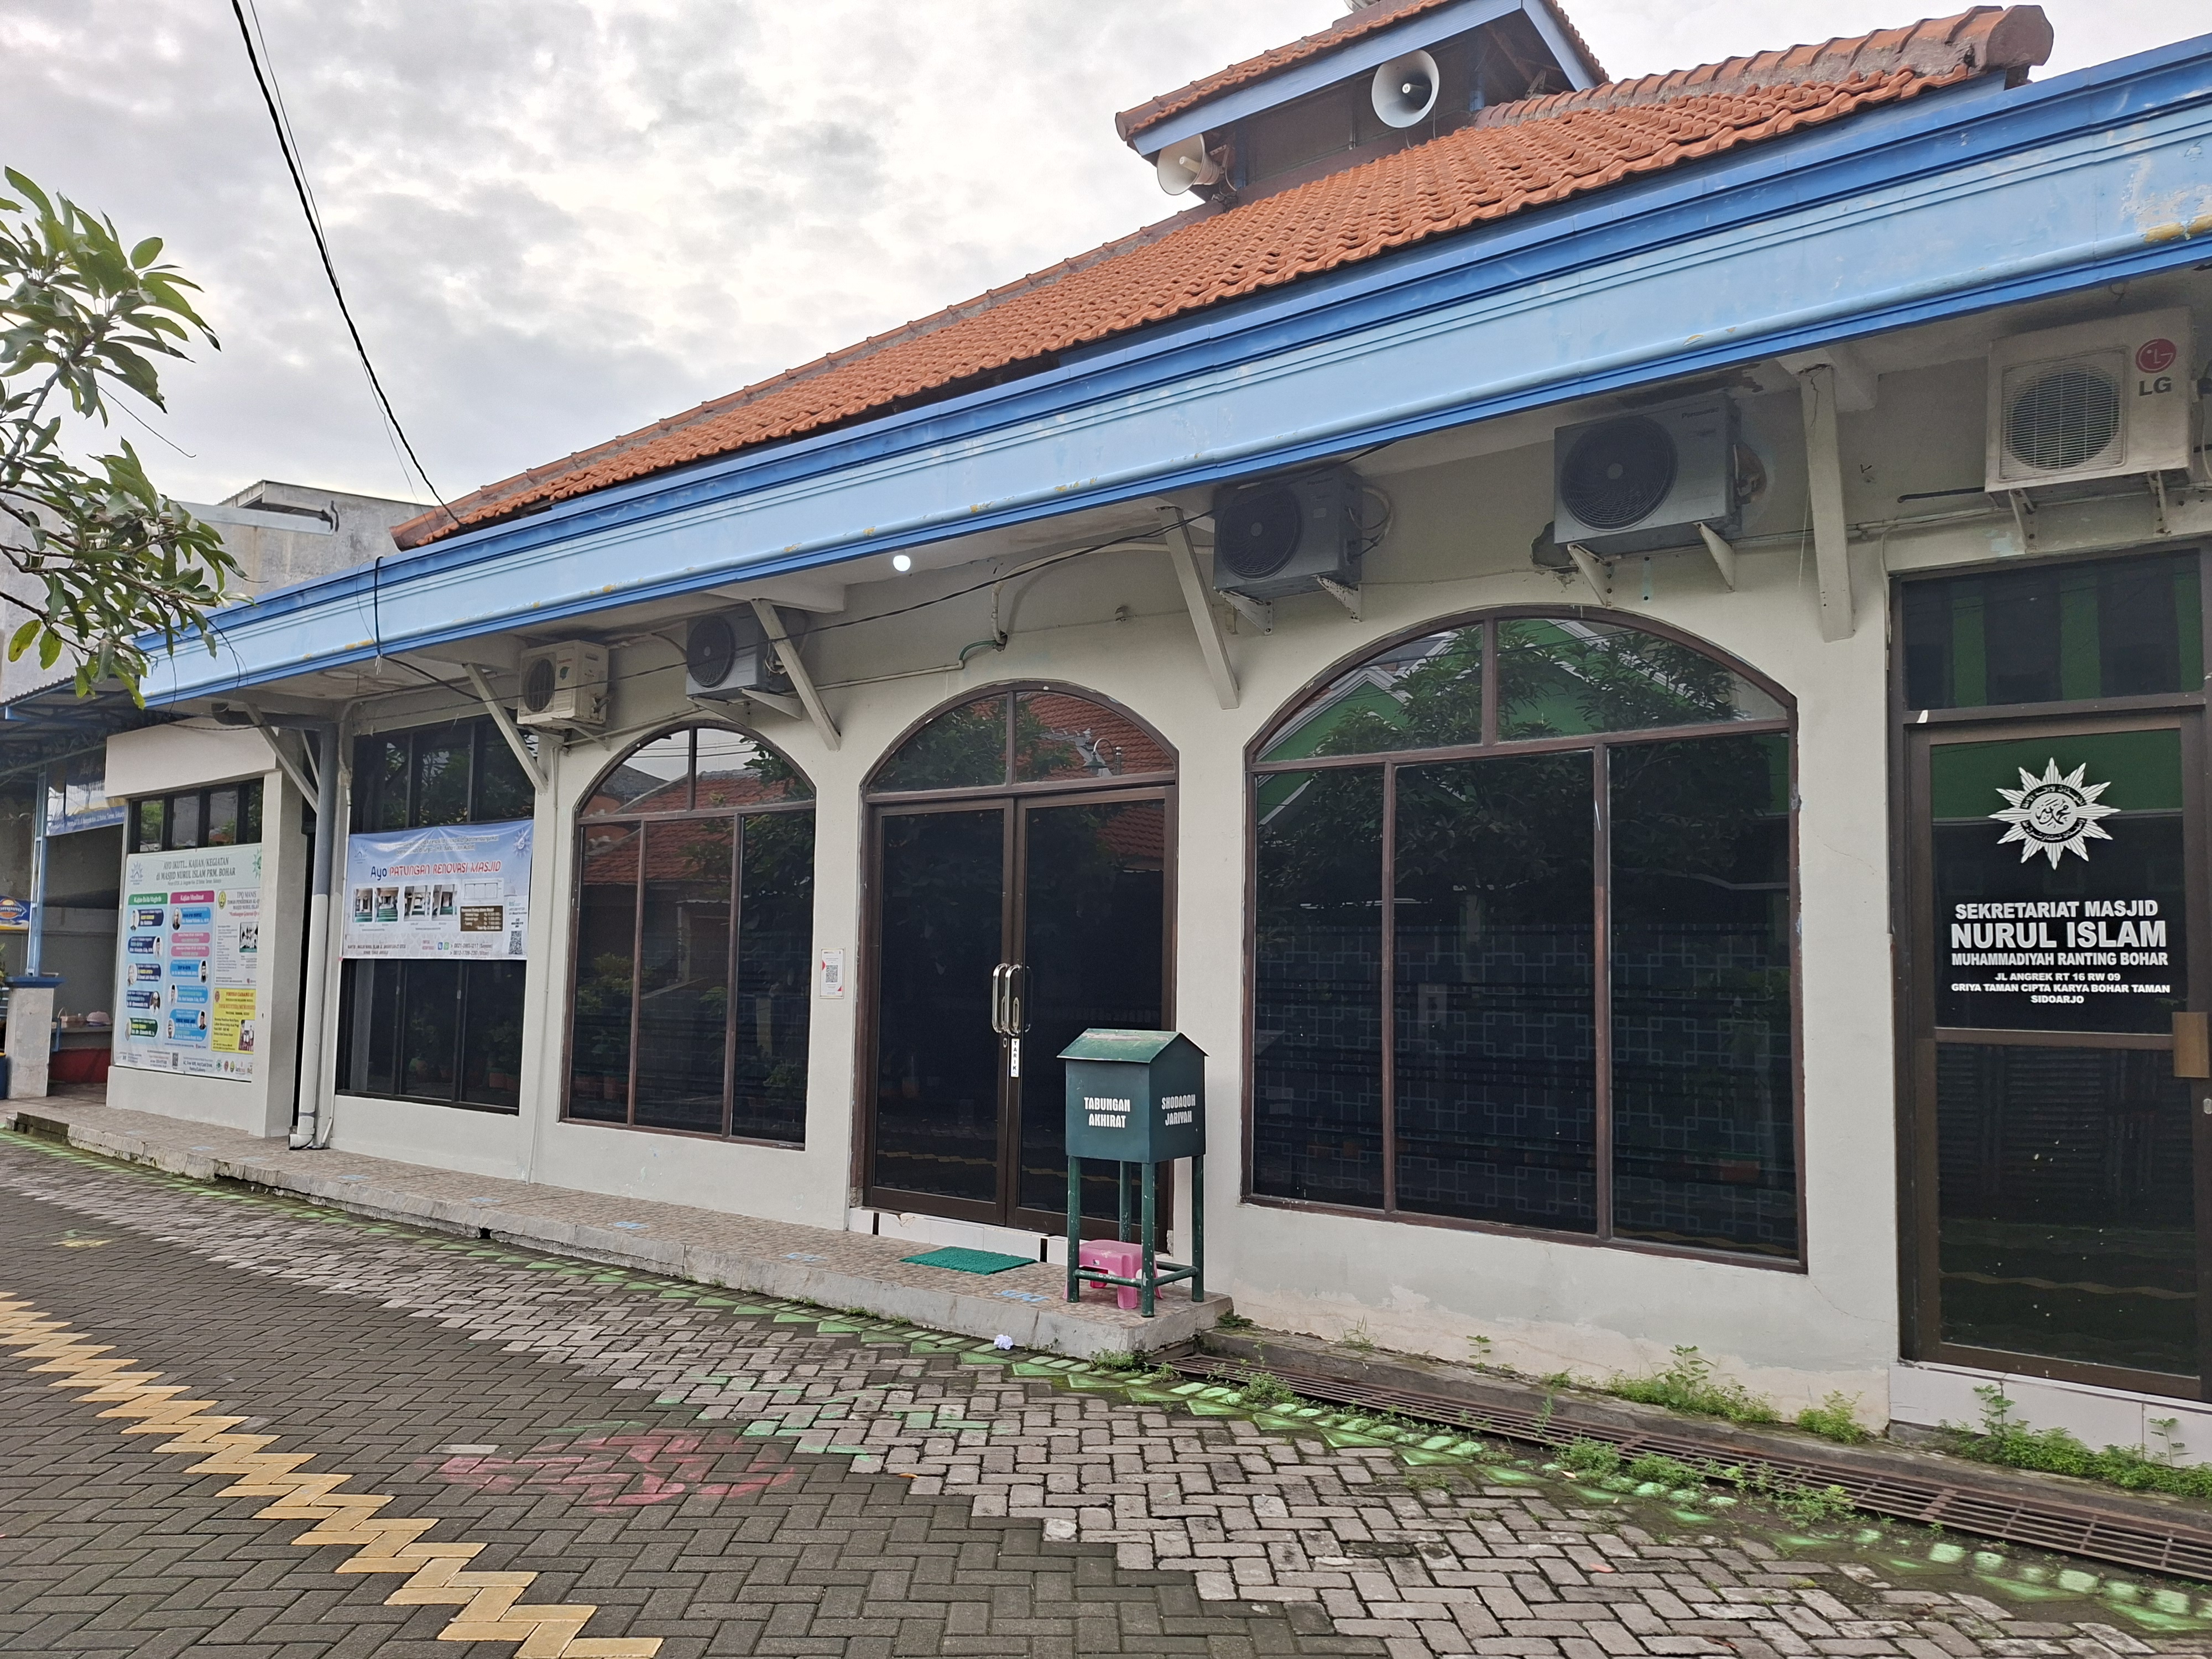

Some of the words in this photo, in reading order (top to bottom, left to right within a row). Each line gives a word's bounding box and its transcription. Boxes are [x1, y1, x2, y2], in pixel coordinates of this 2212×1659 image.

[2139, 377, 2172, 397] LG
[163, 860, 171, 870] AYO
[189, 857, 229, 869] KAJIAN/KEGIATAN
[370, 865, 387, 881] Ayo
[389, 863, 431, 877] PATUNGAN
[433, 862, 469, 874] RENOVASI
[470, 860, 502, 873] MASJID
[161, 872, 176, 881] MASJID
[177, 870, 191, 879] NURUL
[192, 869, 206, 878] ISLAM
[219, 867, 236, 877] BOHAR
[1955, 901, 2080, 919] SEKRETARIAT
[2084, 900, 2158, 917] MASJID
[1951, 922, 2057, 949] NURUL
[2067, 920, 2167, 948] ISLAM
[1952, 952, 2054, 966] MUHAMMADIYAH
[2057, 952, 2117, 966] RANTING
[2120, 952, 2168, 966] BOHAR
[1994, 973, 2008, 982] JL
[2009, 973, 2053, 982] ANGREK
[2055, 973, 2069, 982] RT
[2073, 973, 2085, 982] 16
[2088, 973, 2106, 982] RW
[2107, 973, 2121, 982] 09
[1951, 984, 1981, 992] GRIYA
[1983, 984, 2018, 992] TAMAN
[2021, 984, 2051, 993] CIPTA
[2053, 984, 2089, 993] KARYA
[2091, 984, 2129, 993] BOHAR
[2131, 984, 2171, 993] TAMAN
[2031, 995, 2084, 1004] SIDOARJO
[1084, 1097, 1130, 1112] TABUNGAN
[1161, 1094, 1196, 1110] SHODAQOH
[1088, 1113, 1126, 1128] AKHIRAT
[1165, 1110, 1192, 1126] JARIYAH
